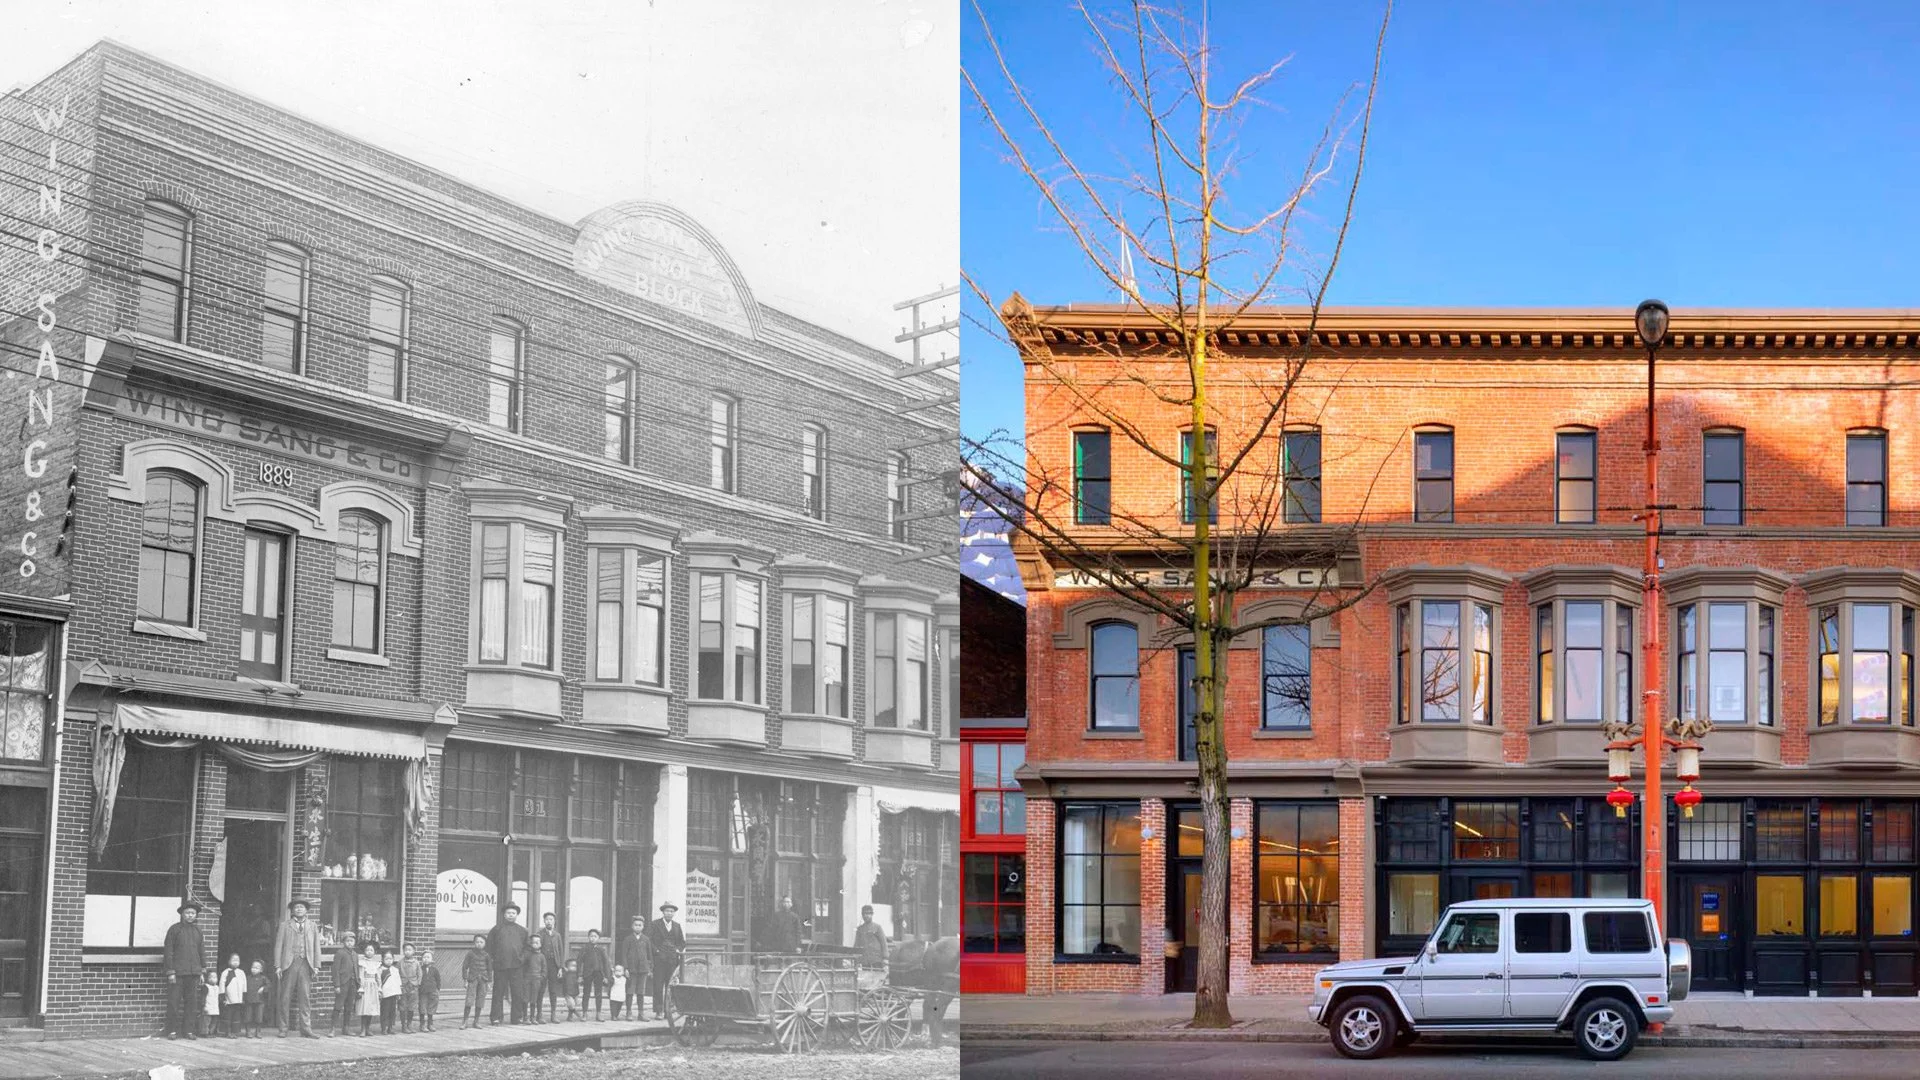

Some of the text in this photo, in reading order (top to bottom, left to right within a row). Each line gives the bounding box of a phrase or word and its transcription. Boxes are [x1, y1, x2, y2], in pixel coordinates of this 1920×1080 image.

[33, 94, 71, 262] WING
[634, 270, 705, 317] BLOCK
[24, 292, 59, 479] SANG
[124, 387, 227, 433] WING
[238, 416, 337, 461] SANG
[346, 445, 372, 470] &
[258, 461, 294, 488] 1889
[436, 892, 457, 904] OOL
